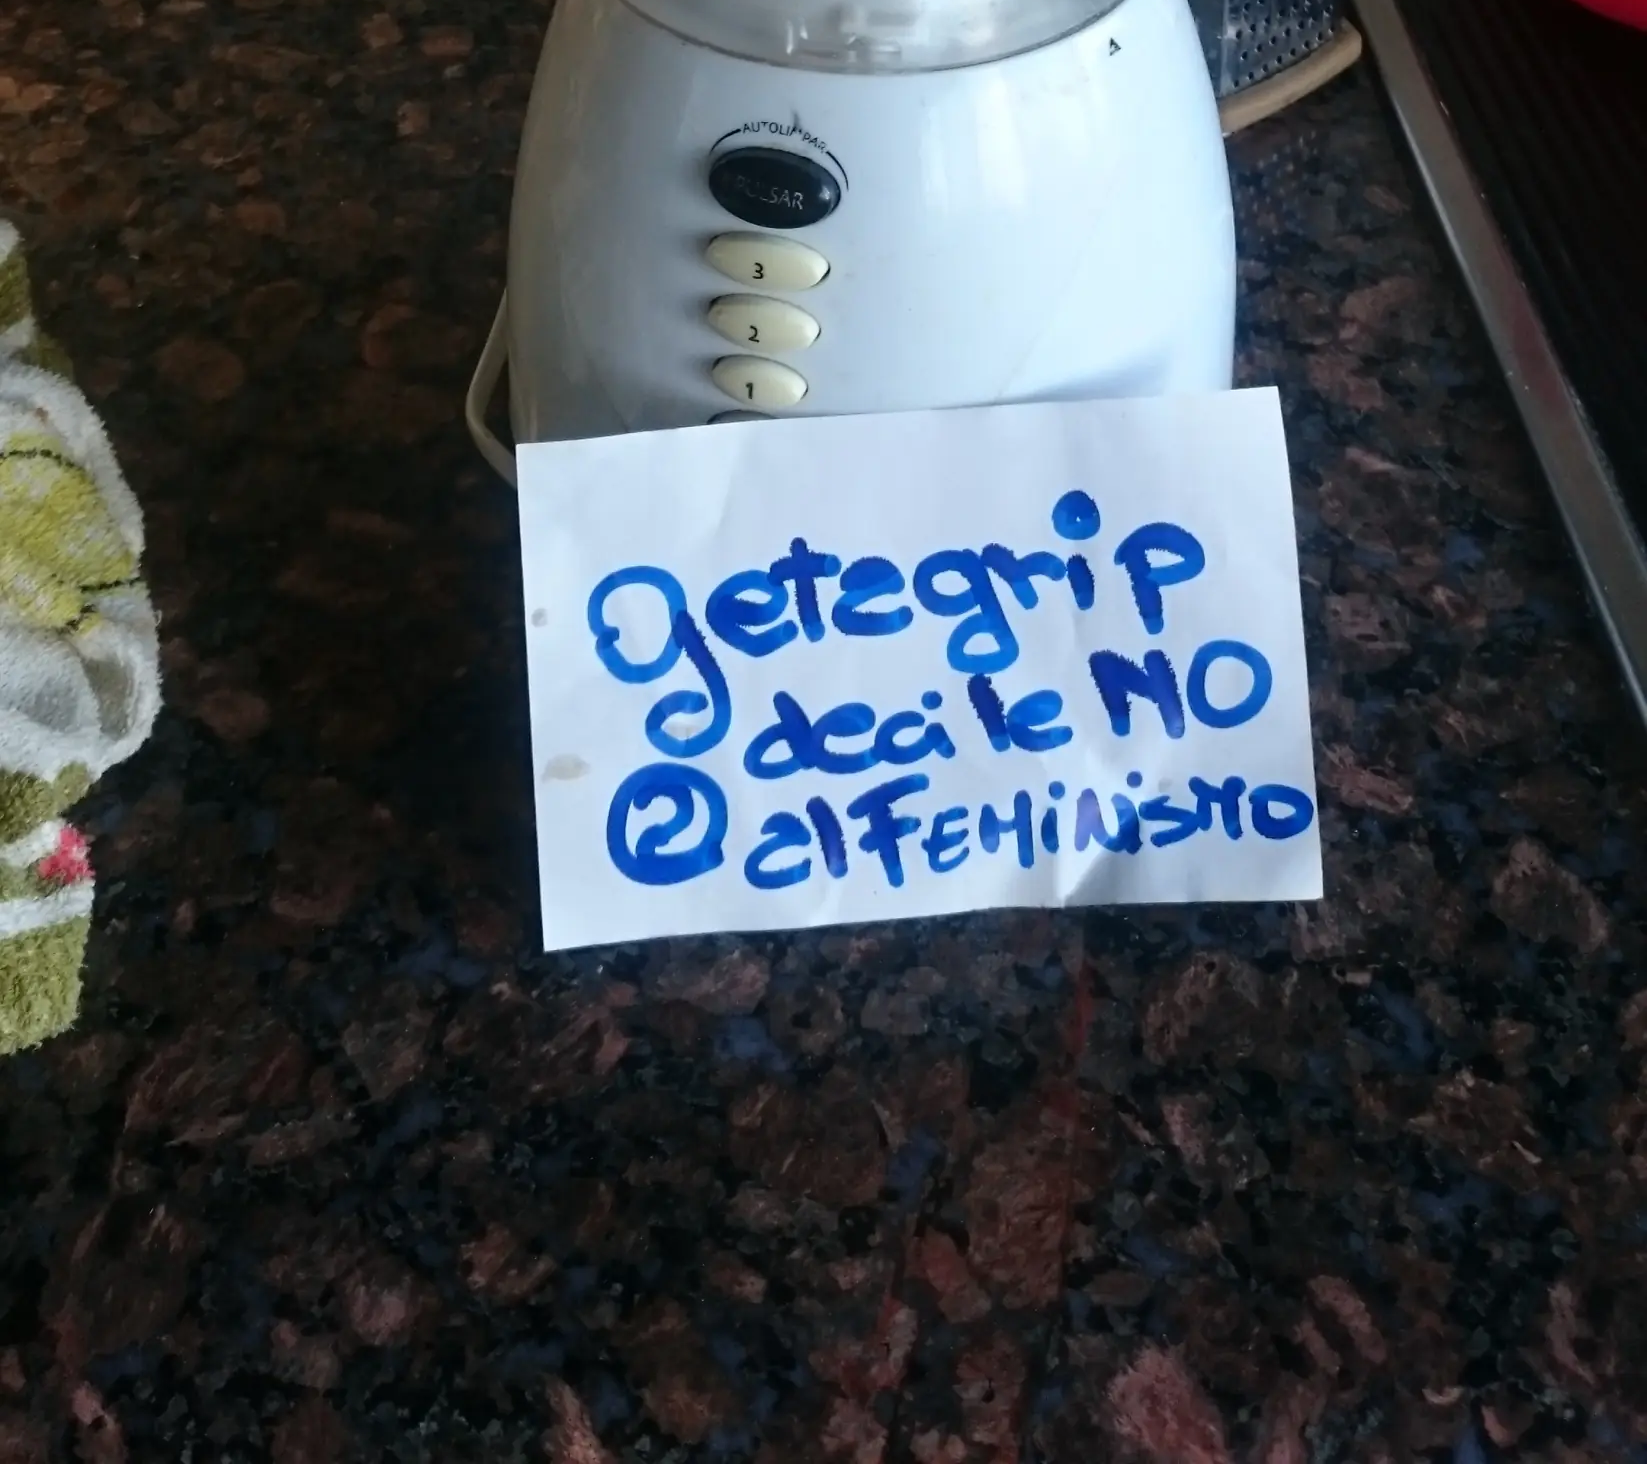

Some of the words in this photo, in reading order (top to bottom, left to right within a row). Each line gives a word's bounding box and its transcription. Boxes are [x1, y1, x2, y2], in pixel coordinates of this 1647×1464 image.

[753, 262, 764, 280] 3
[748, 325, 760, 343] 2
[745, 382, 754, 400] 1
[1089, 640, 1273, 739] NO
